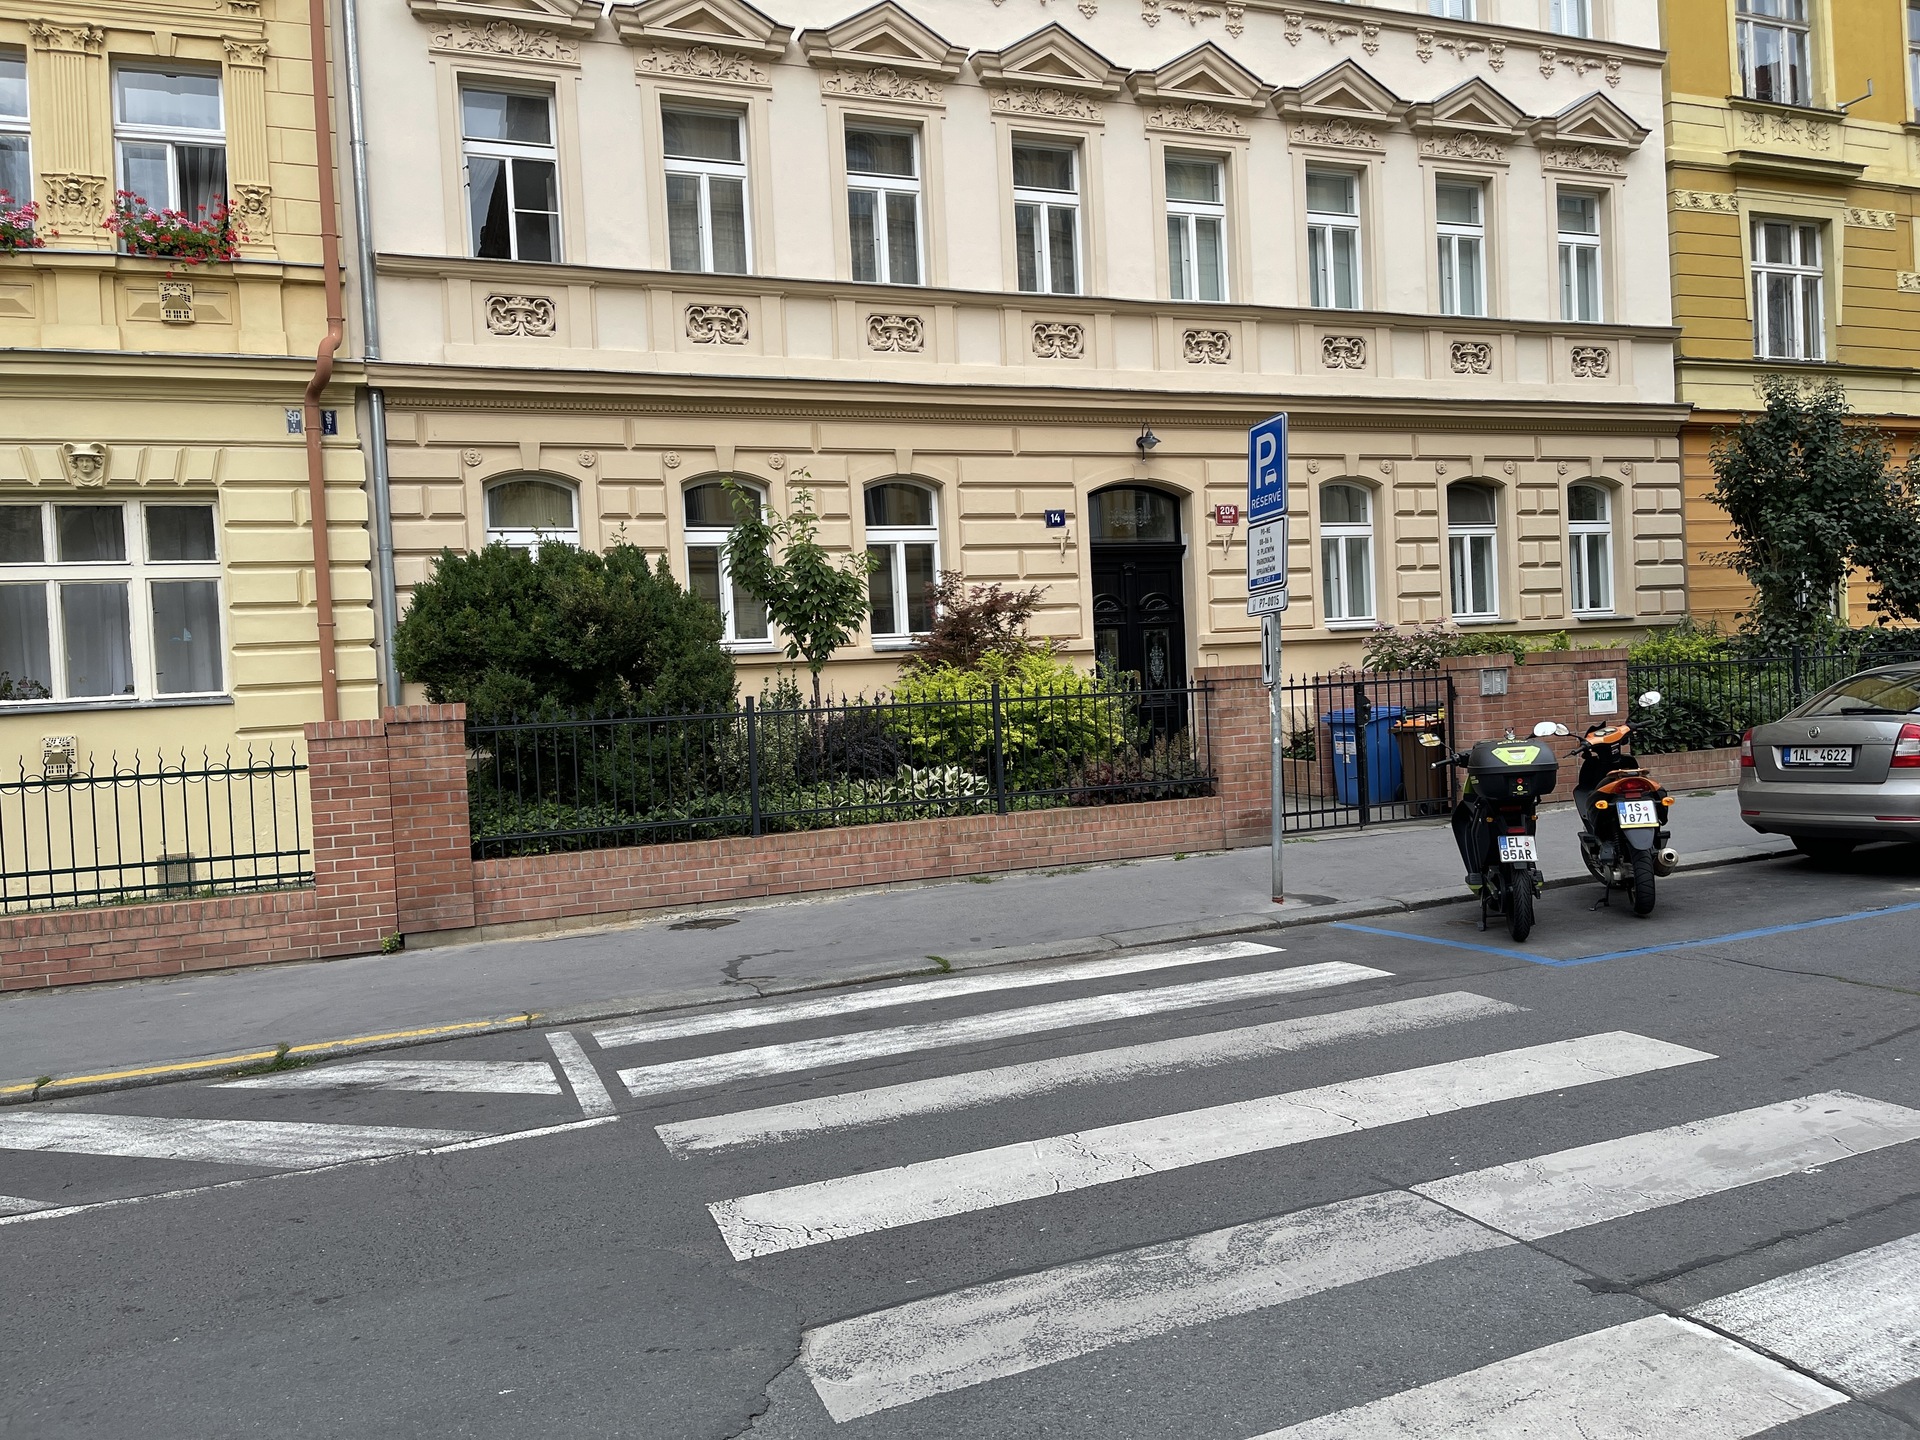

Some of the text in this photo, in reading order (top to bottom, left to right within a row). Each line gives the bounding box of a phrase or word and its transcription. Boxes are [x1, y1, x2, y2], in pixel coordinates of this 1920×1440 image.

[1256, 432, 1276, 489] P
[1251, 488, 1282, 510] RÉSERVÉ
[1220, 506, 1235, 515] 204
[1050, 513, 1061, 523] 14
[1259, 595, 1280, 608] P7-0015
[1597, 692, 1610, 700] HUP
[1793, 749, 1847, 761] 1AL 4622
[1627, 803, 1641, 812] 1S
[1621, 812, 1650, 823] Y871
[1507, 837, 1522, 848] EL
[1502, 849, 1532, 860] 95AR
